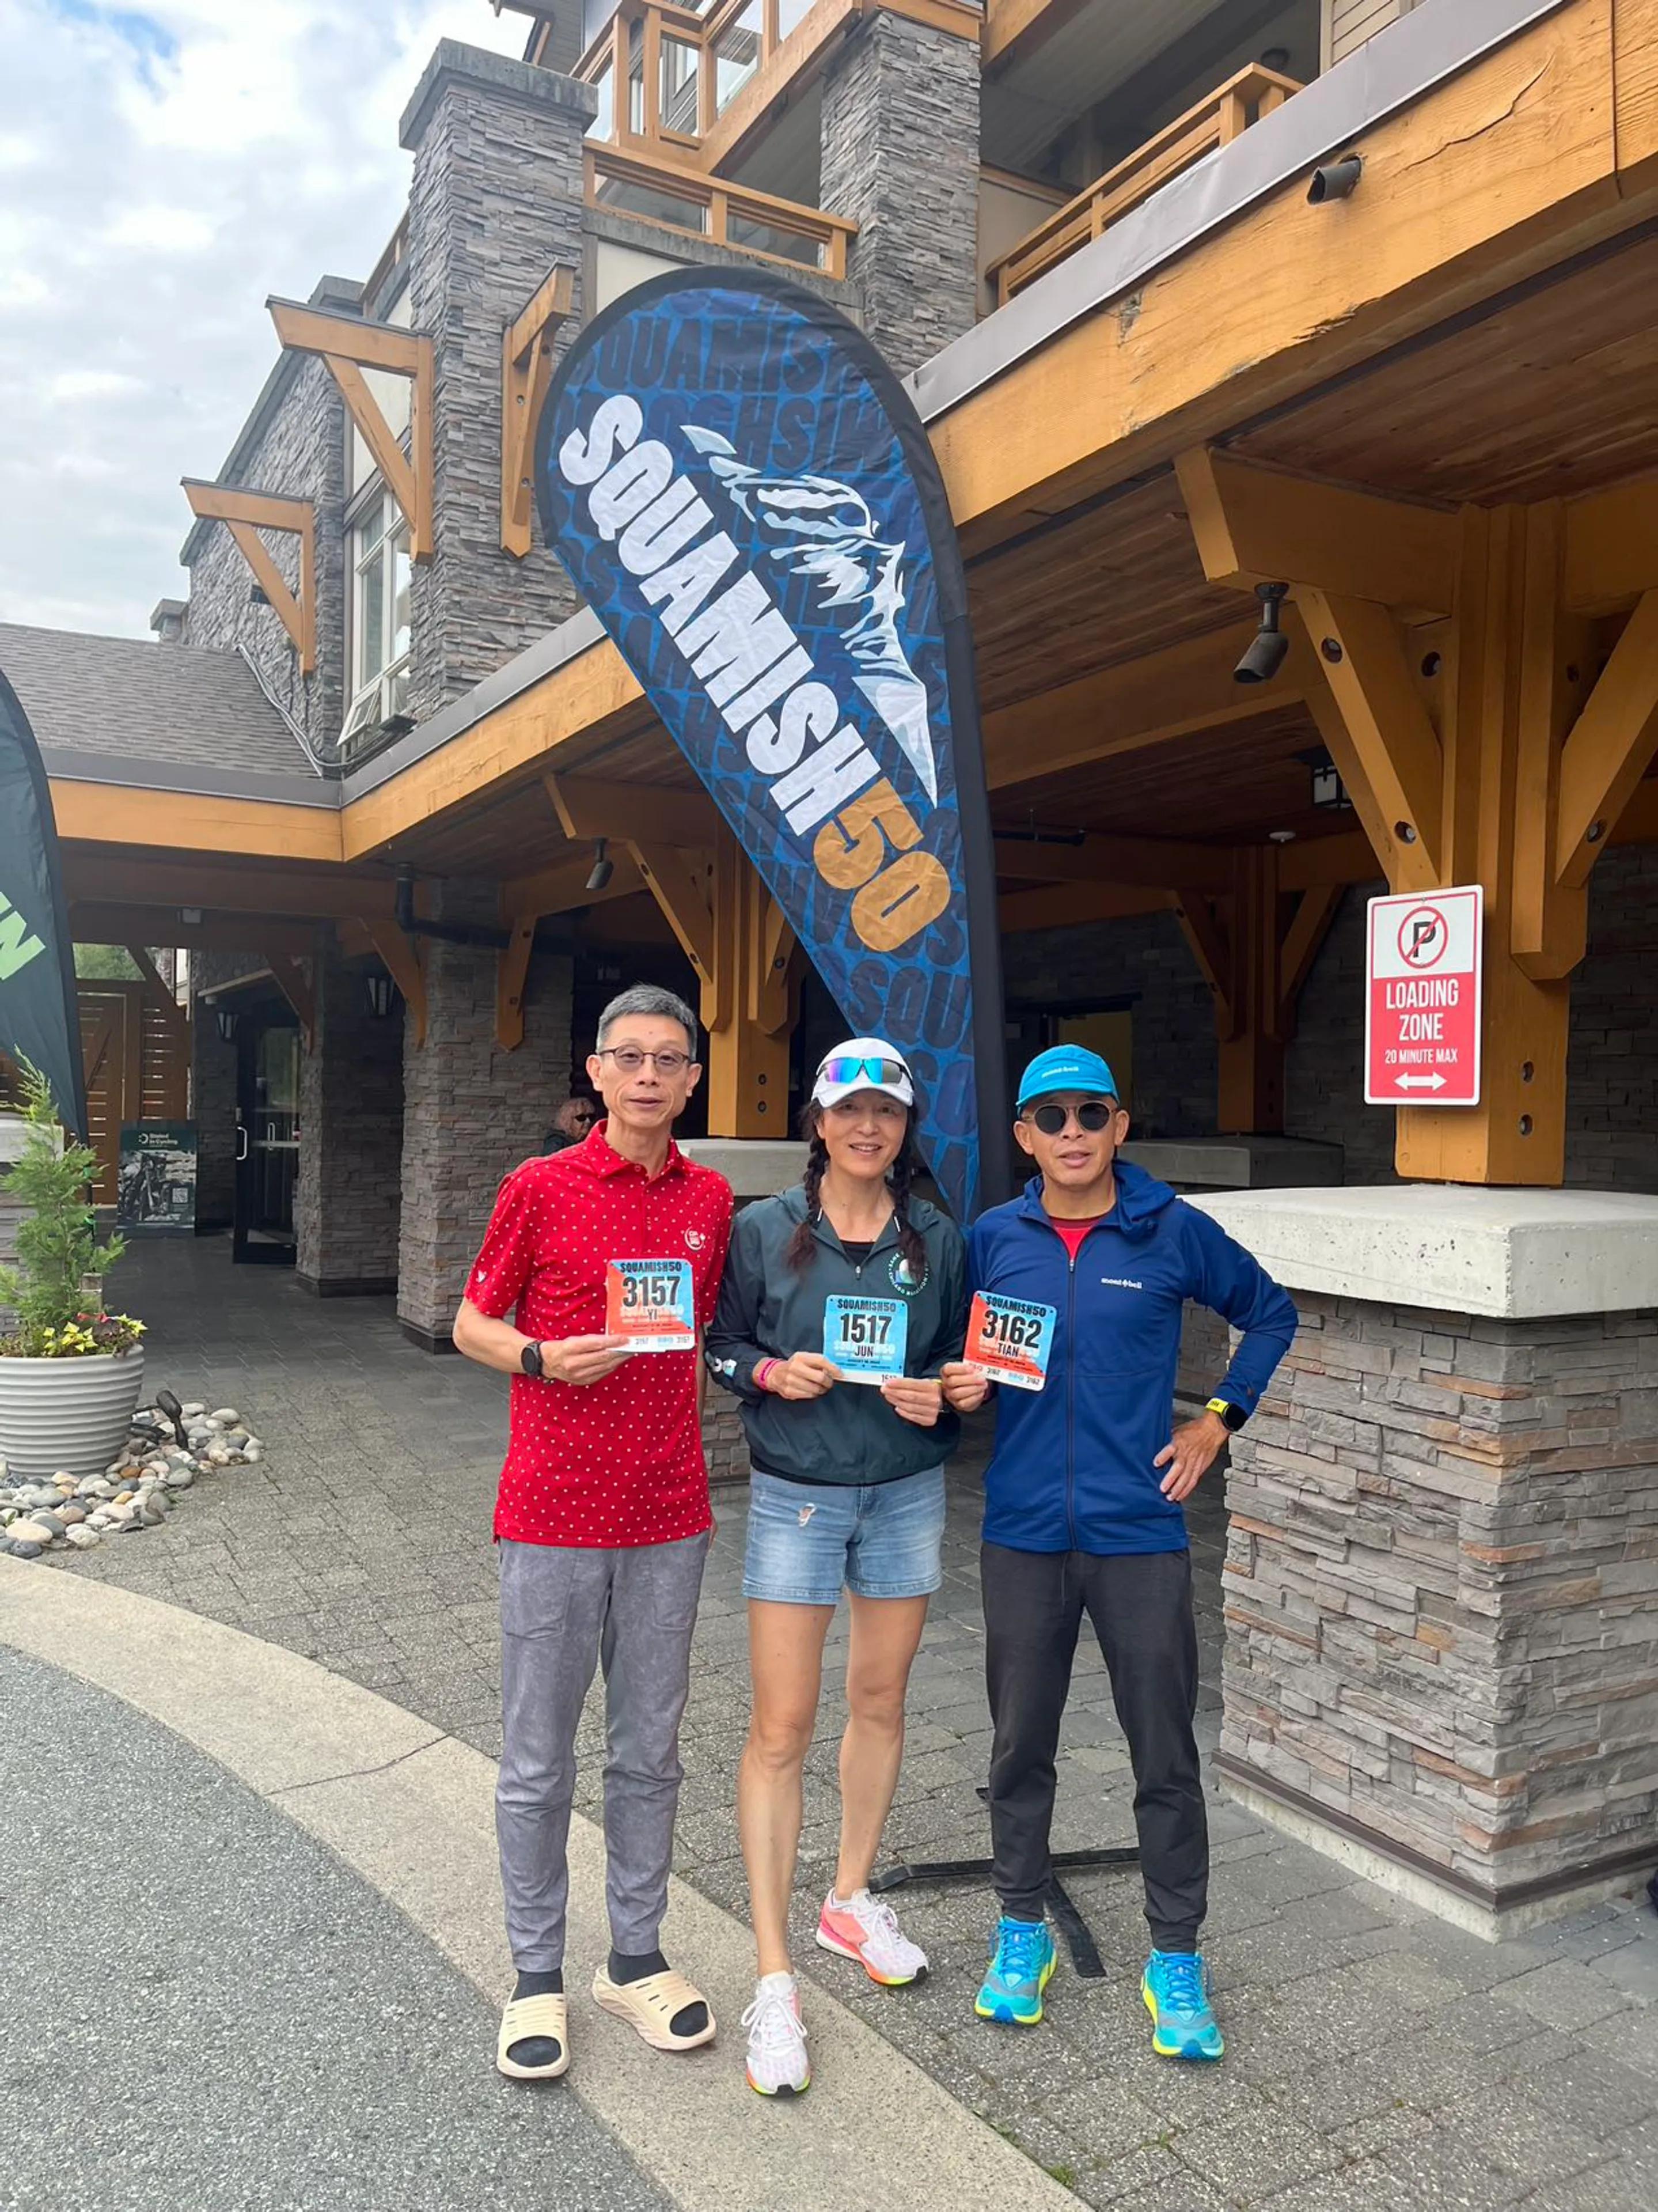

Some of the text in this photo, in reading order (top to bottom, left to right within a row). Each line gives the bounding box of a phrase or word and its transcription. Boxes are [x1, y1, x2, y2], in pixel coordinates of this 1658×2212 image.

[1386, 979, 1459, 1010] LOADING
[1399, 1013, 1444, 1041] ZONE
[1385, 1047, 1458, 1064] 20 MINUTE MAX
[620, 1262, 682, 1274] SQUAMISH50
[623, 1277, 681, 1307] 3157
[647, 1308, 658, 1320] YI
[837, 1298, 896, 1312] SQUAMISH50
[986, 1296, 1047, 1317] SQUAMISH50
[840, 1313, 892, 1344] 1517
[982, 1310, 1042, 1349] 3162
[855, 1345, 874, 1357] JUN
[997, 1342, 1019, 1357] TIAN
